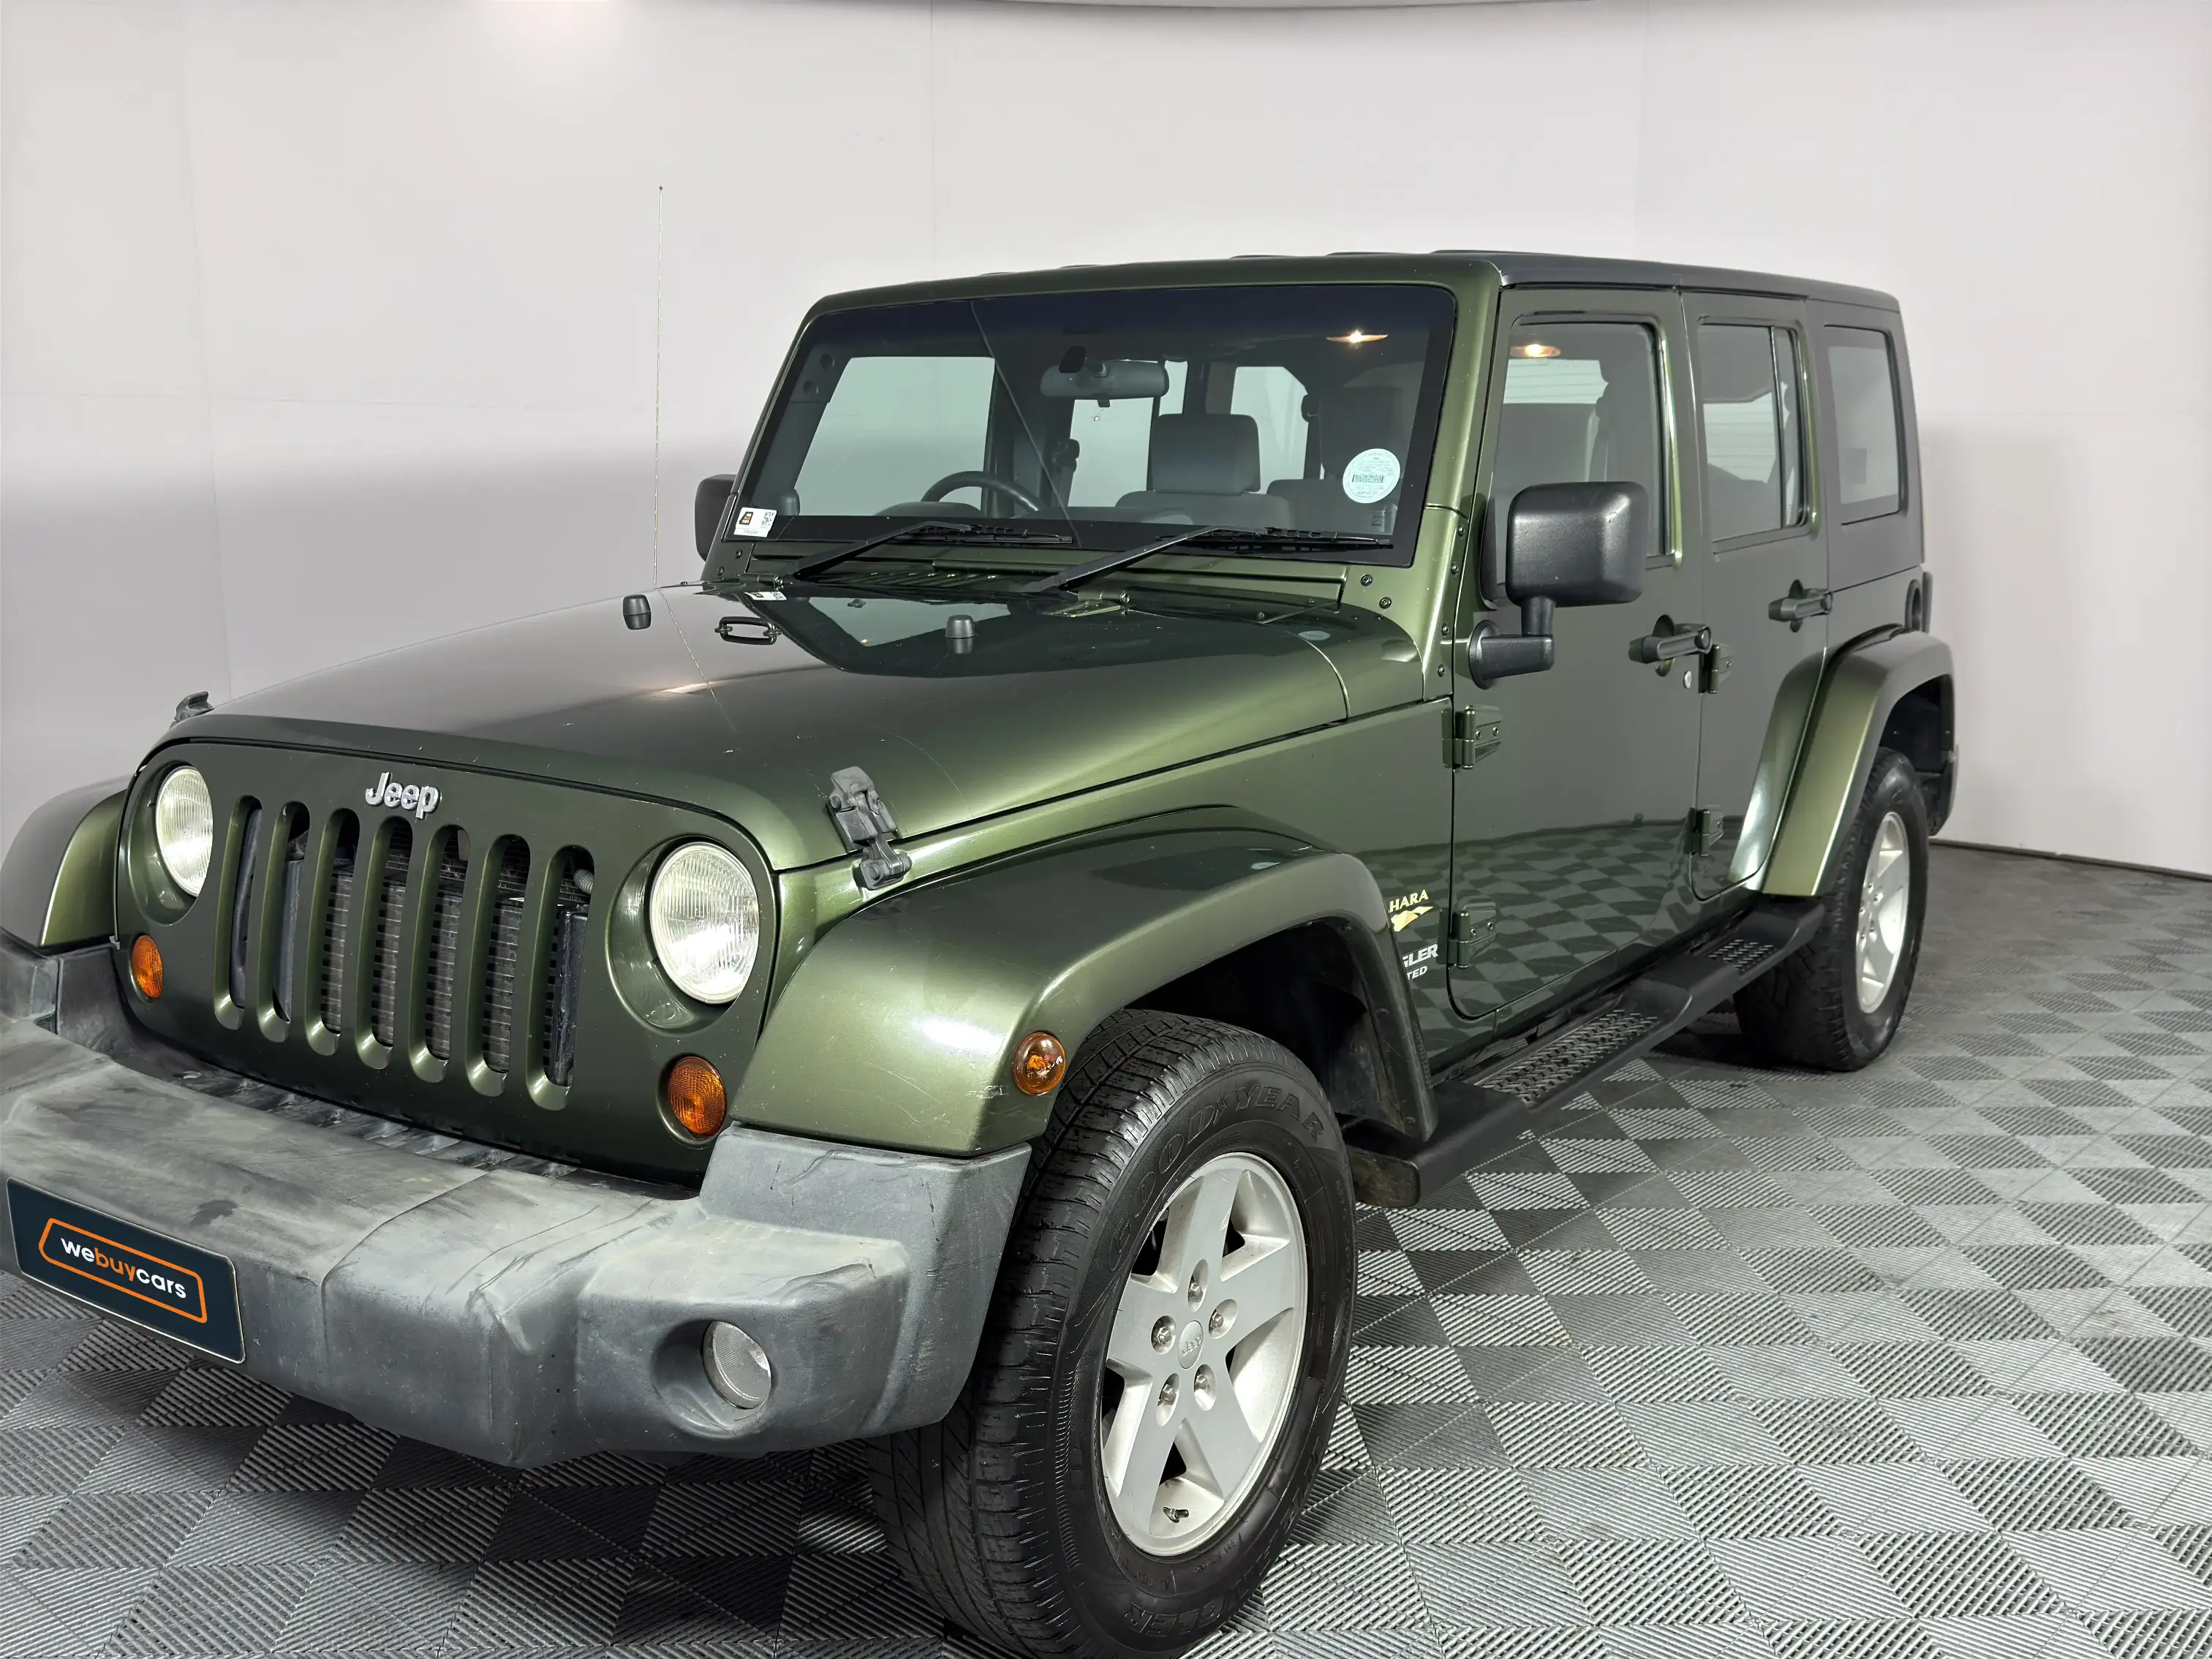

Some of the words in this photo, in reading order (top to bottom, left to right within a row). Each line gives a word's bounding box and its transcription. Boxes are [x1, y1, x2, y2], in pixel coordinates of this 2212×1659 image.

[366, 772, 442, 819] Jeep
[1389, 889, 1429, 912] HARA
[1108, 1083, 1325, 1272] GOODYEAR
[61, 1238, 186, 1299] webuycars
